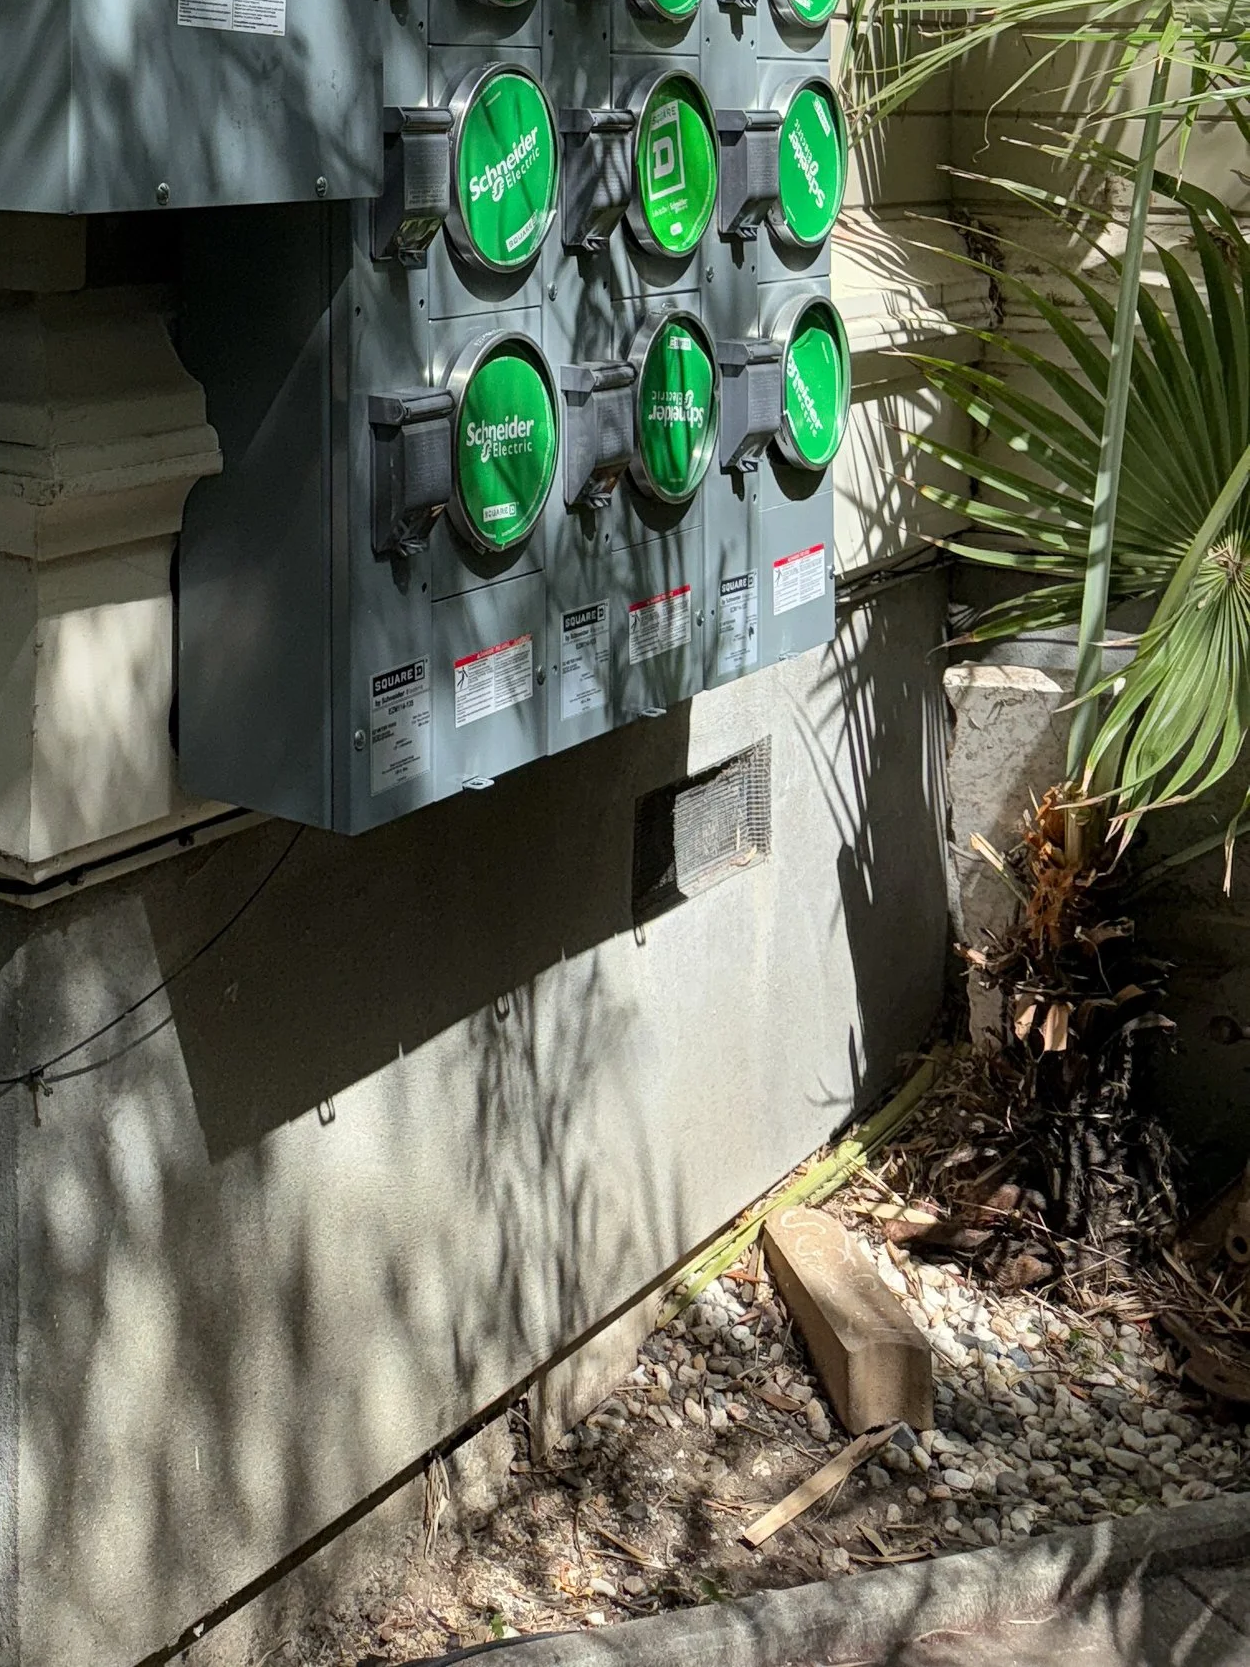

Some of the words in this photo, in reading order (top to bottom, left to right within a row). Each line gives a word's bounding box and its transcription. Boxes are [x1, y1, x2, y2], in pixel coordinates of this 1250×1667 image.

[469, 126, 538, 202] Schneider
[506, 147, 540, 189] Electric
[653, 136, 675, 180] D
[652, 390, 683, 406] Electric
[649, 404, 704, 428] Schneider
[466, 415, 534, 446] Schneider
[493, 439, 532, 458] Electric
[722, 577, 747, 593] SQUARE
[565, 610, 596, 628] SQUARE
[375, 669, 413, 692] SQUARE
